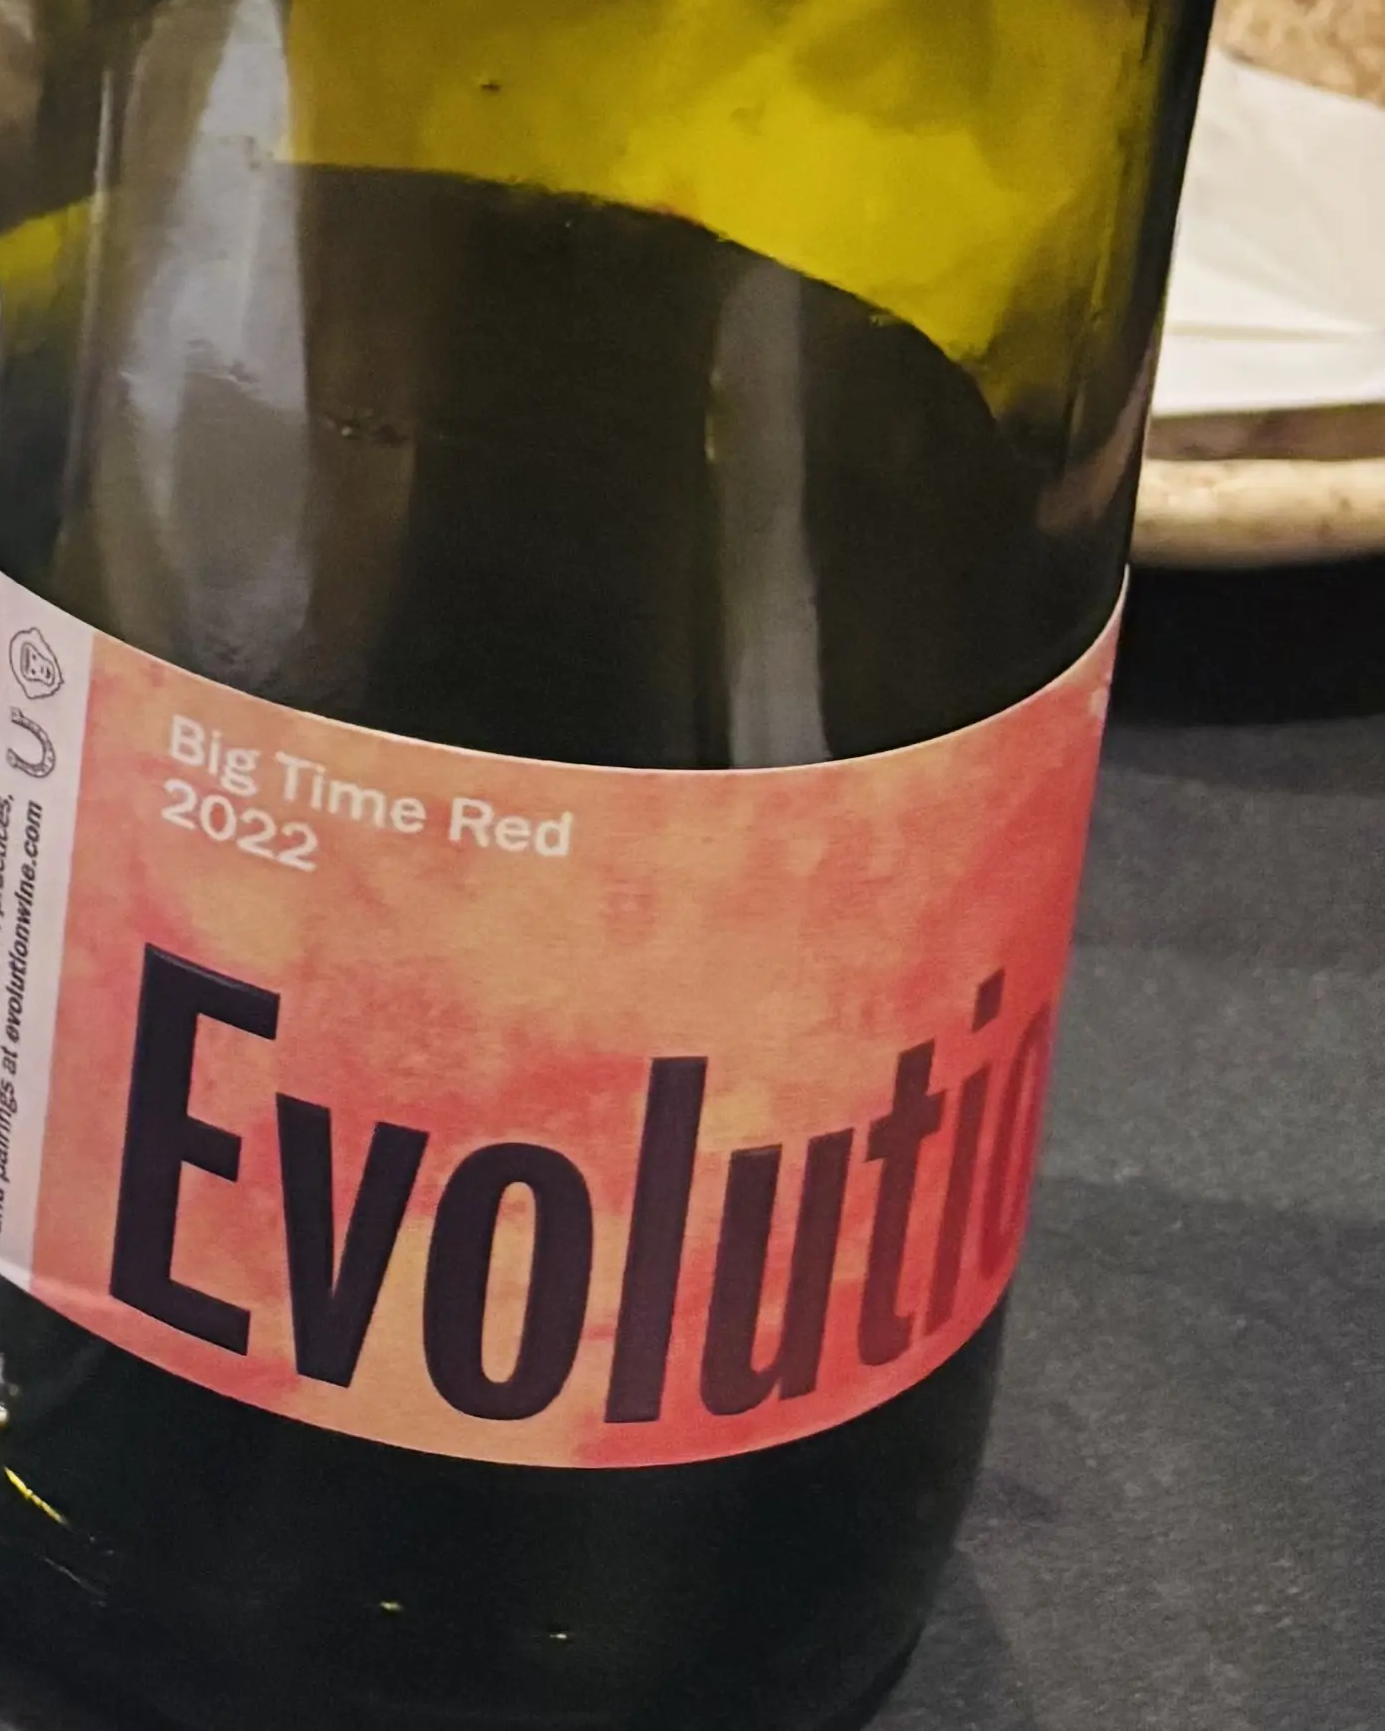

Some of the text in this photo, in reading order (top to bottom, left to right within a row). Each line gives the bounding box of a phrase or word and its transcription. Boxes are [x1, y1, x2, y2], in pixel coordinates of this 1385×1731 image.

[161, 777, 320, 873] 2022
[168, 714, 573, 858] Big Time Red
[5, 799, 43, 1044] evolutionwine.com
[0, 1044, 19, 1076] at
